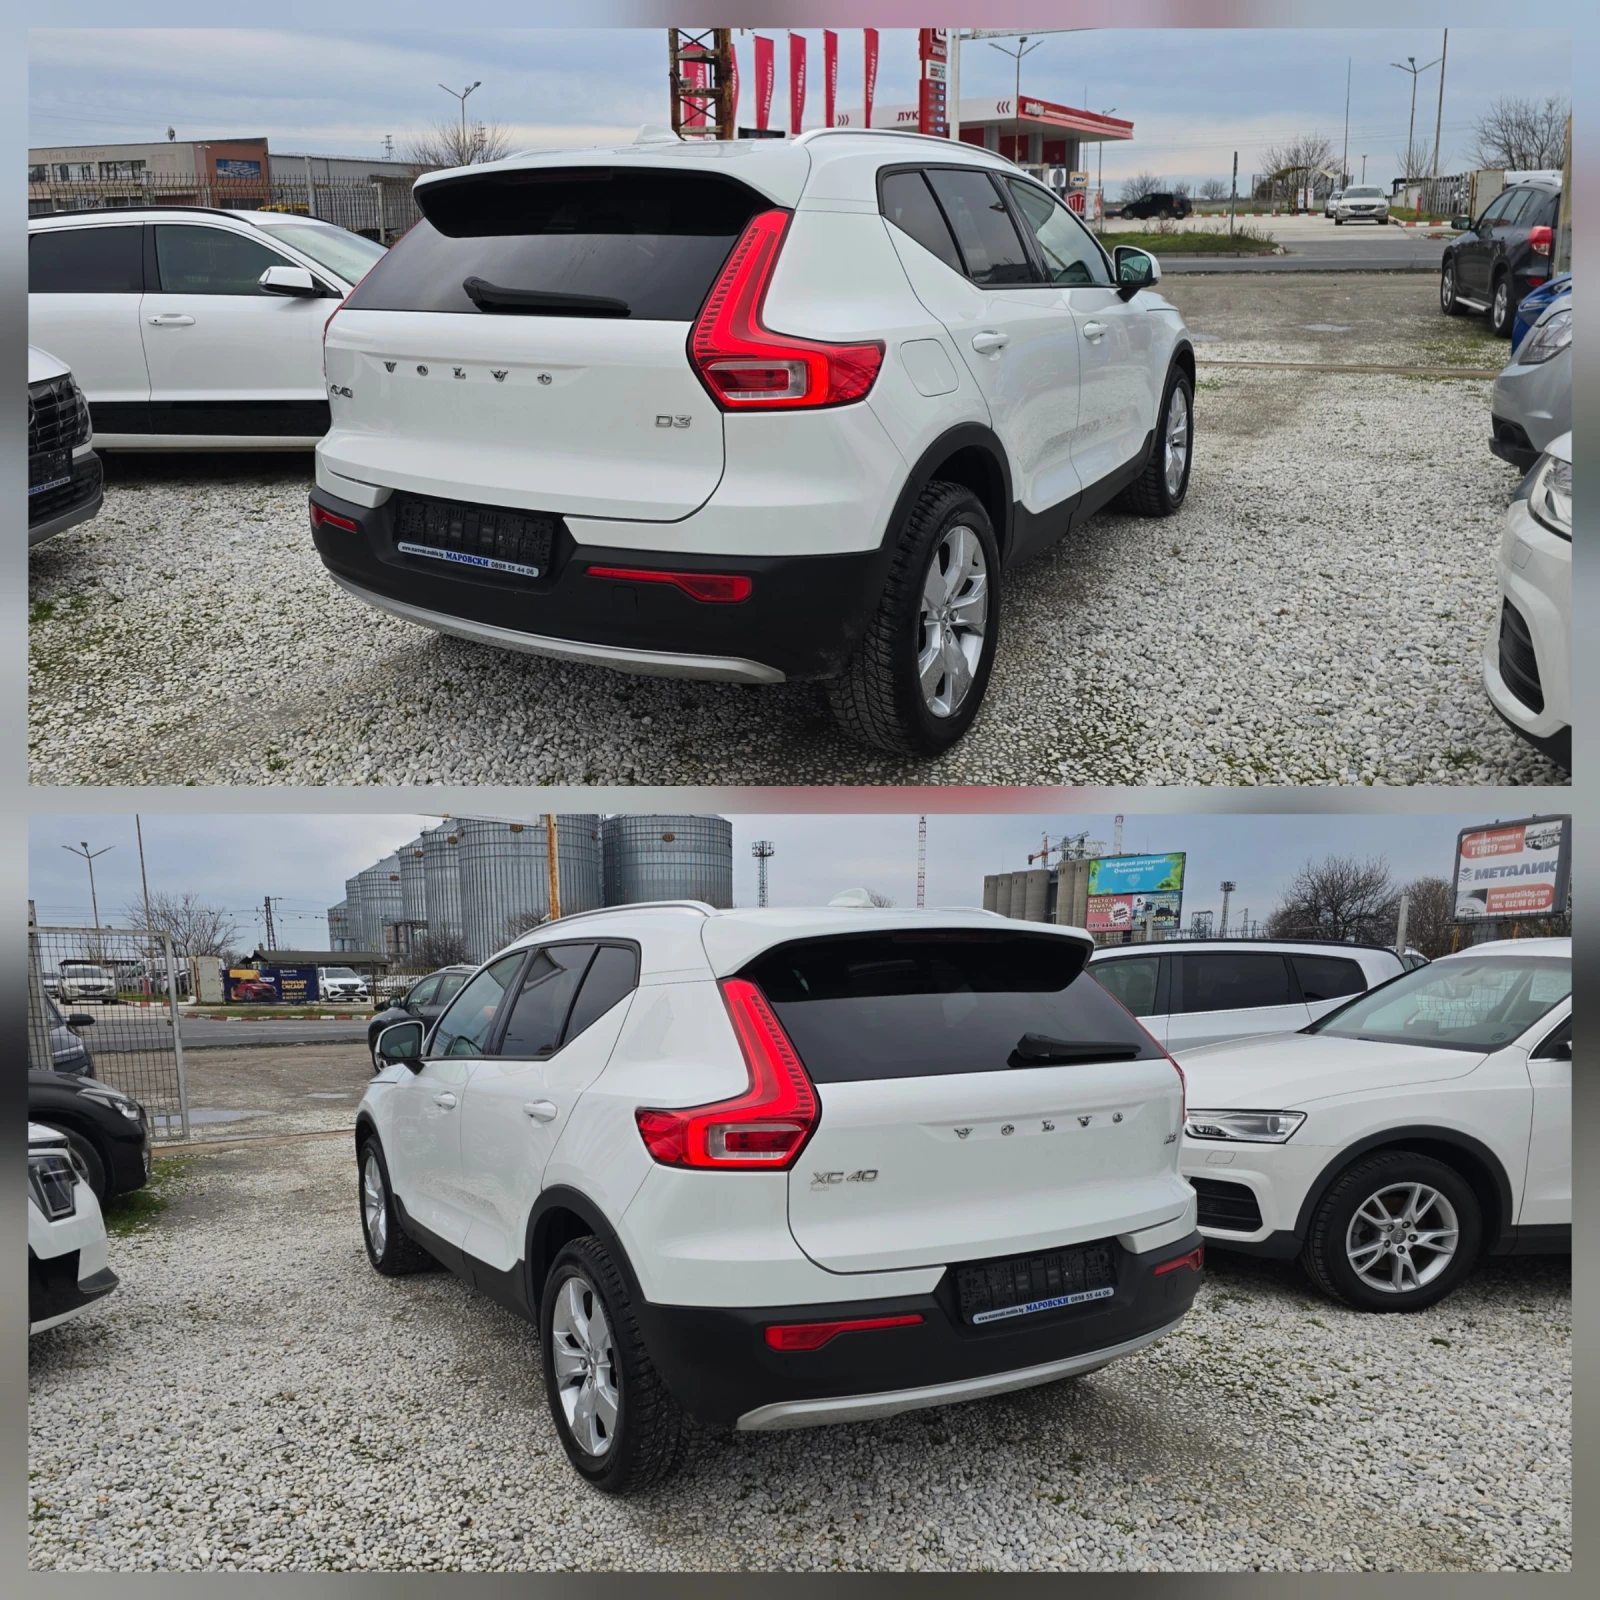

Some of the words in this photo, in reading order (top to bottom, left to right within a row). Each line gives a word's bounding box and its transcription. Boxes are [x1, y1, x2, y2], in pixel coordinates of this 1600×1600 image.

[897, 111, 919, 121] ЛУК
[383, 361, 552, 385] VOLVO
[655, 414, 692, 428] D3
[491, 561, 507, 570] 0898
[508, 564, 515, 572] 55
[1106, 860, 1135, 868] Шофирай
[1136, 858, 1166, 867] разумно!
[1475, 860, 1558, 880] МЕТАЛИК
[1491, 889, 1550, 900] www.metalikbg.com
[1528, 898, 1536, 906] 01
[954, 1112, 1123, 1139] VOLVO
[1070, 1295, 1084, 1303] 0898
[1085, 1292, 1093, 1300] 55
[1103, 1289, 1110, 1297] 06
